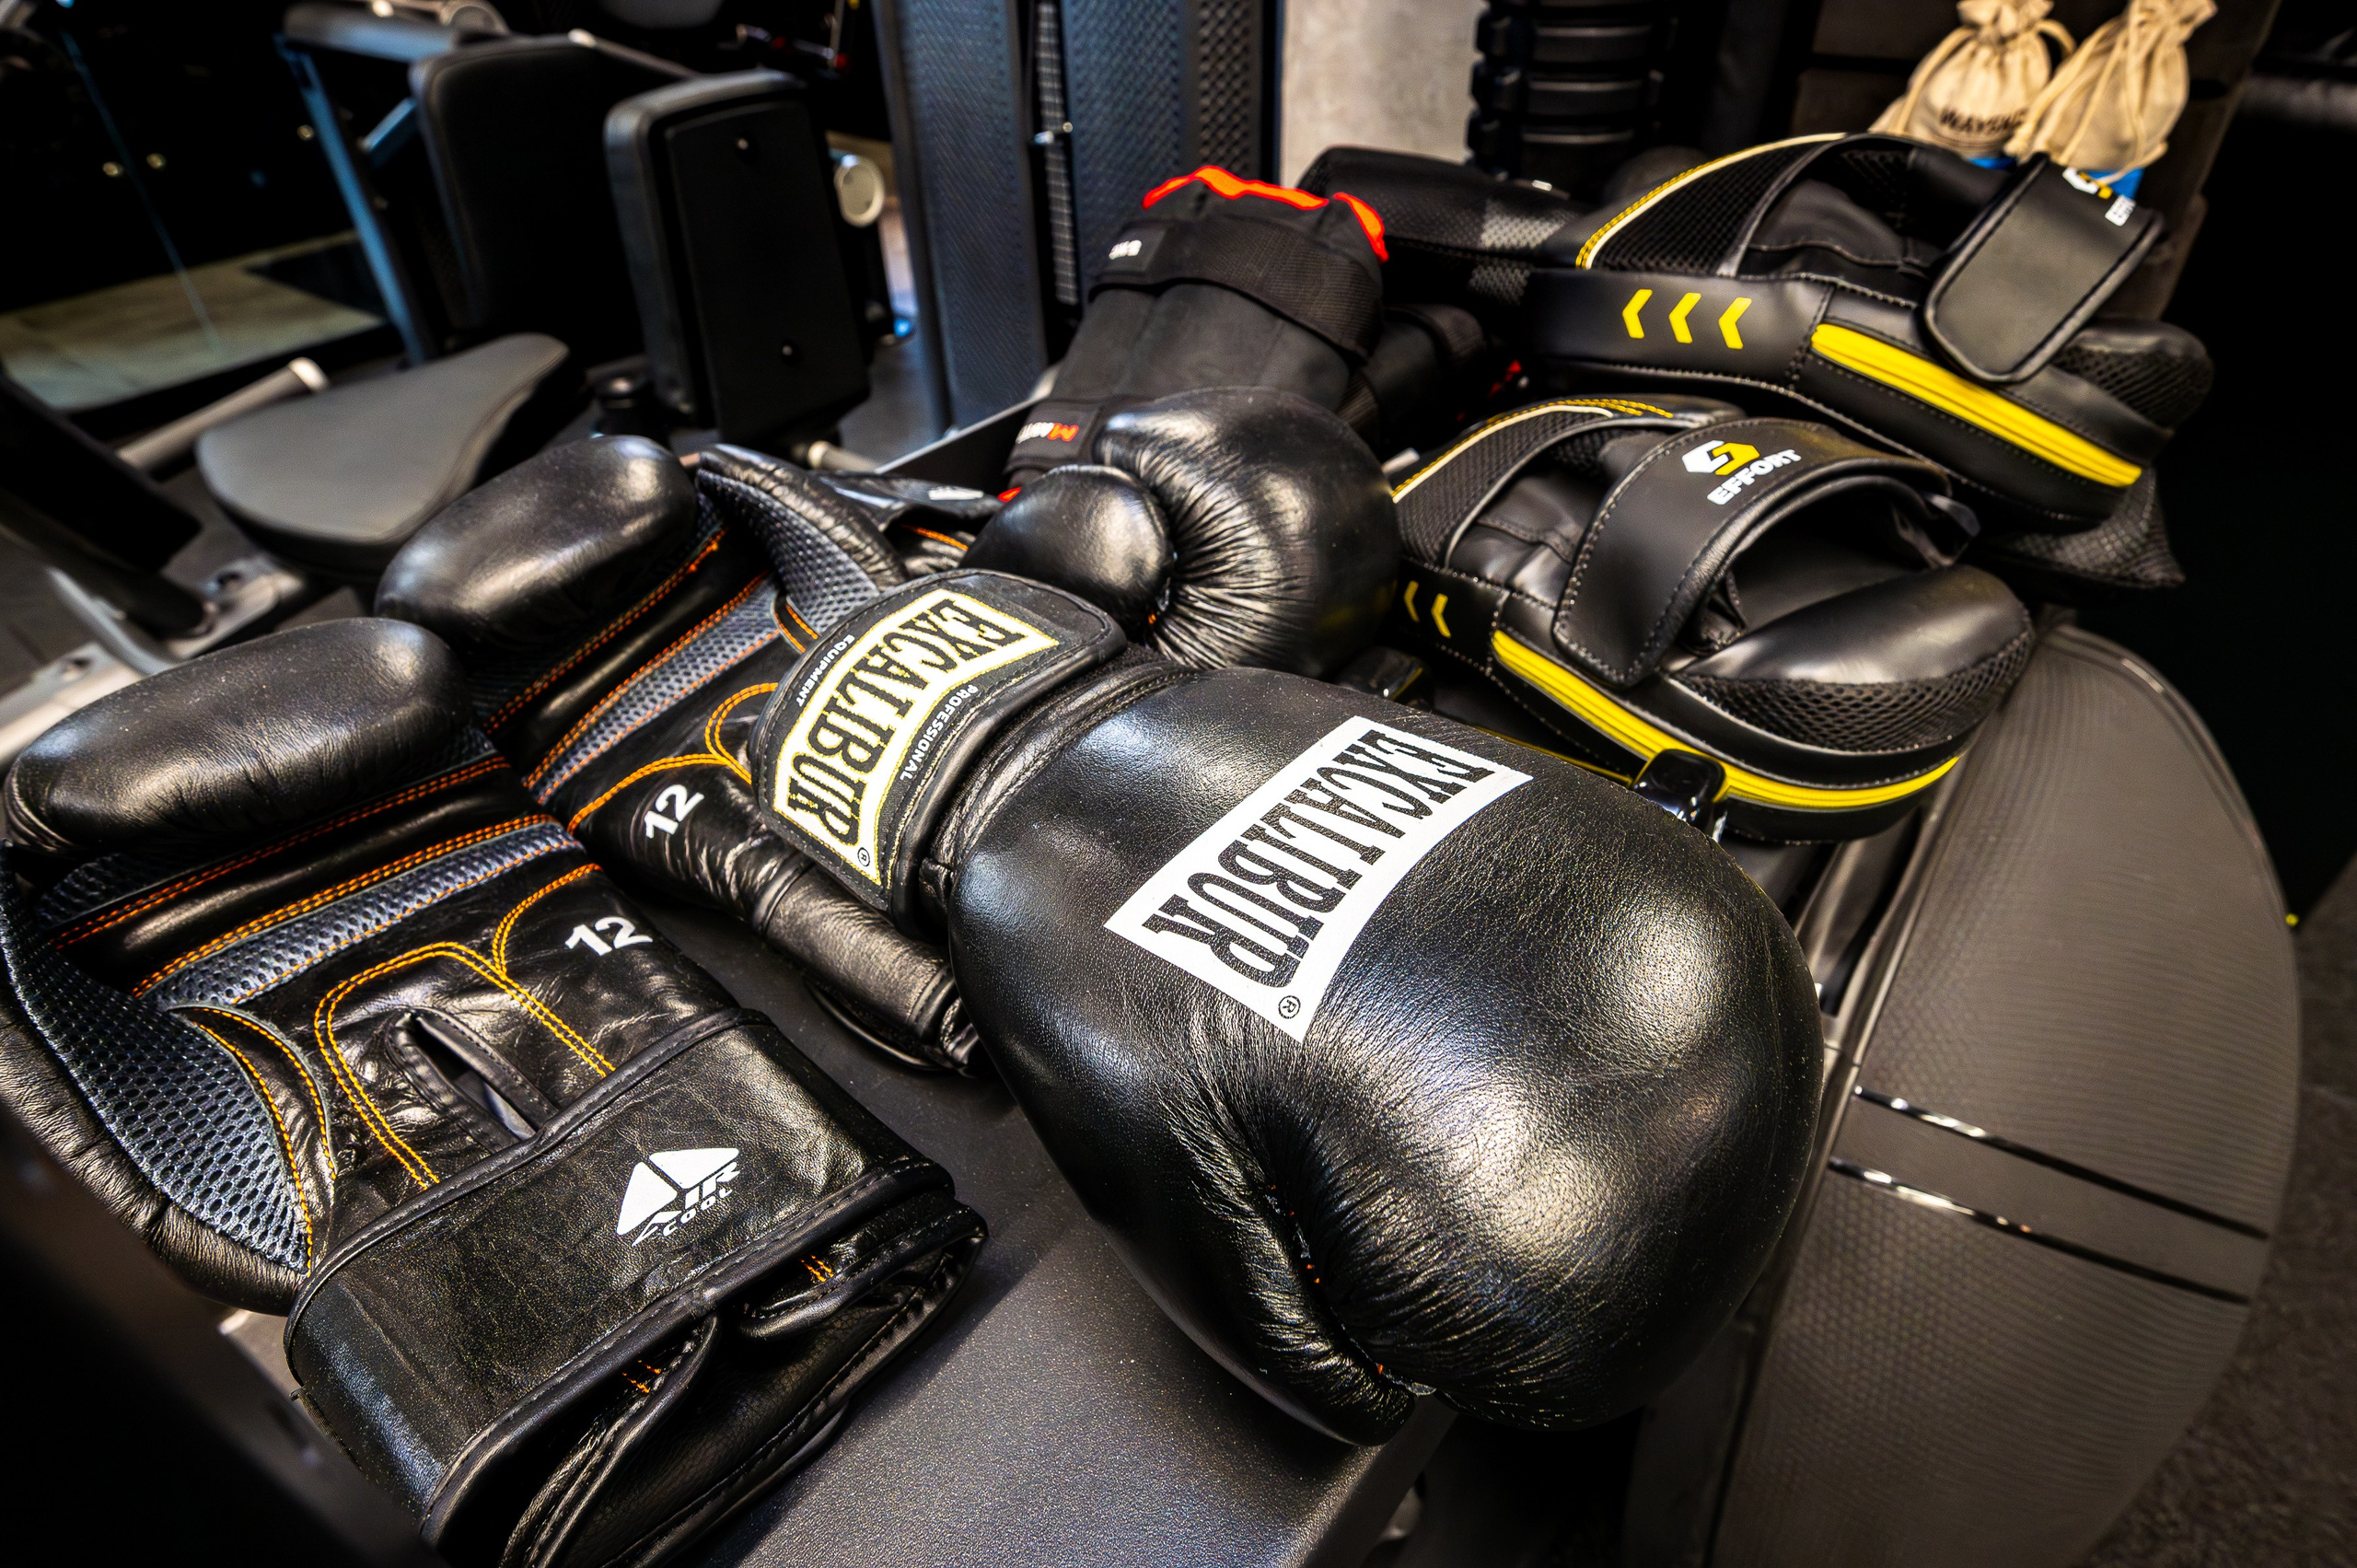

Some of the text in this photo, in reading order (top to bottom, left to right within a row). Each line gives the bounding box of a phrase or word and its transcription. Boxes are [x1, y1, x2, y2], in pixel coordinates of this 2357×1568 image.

[1706, 448, 1802, 505] EFFORT
[795, 633, 856, 707] EQUIPMENT
[786, 598, 1030, 846] EXCALIBUR
[899, 684, 979, 782] PROFESSIONAL
[644, 784, 705, 839] 12
[1142, 729, 1495, 988] EXCALIBUR
[564, 916, 653, 957] 12
[662, 1187, 733, 1237] COOL
